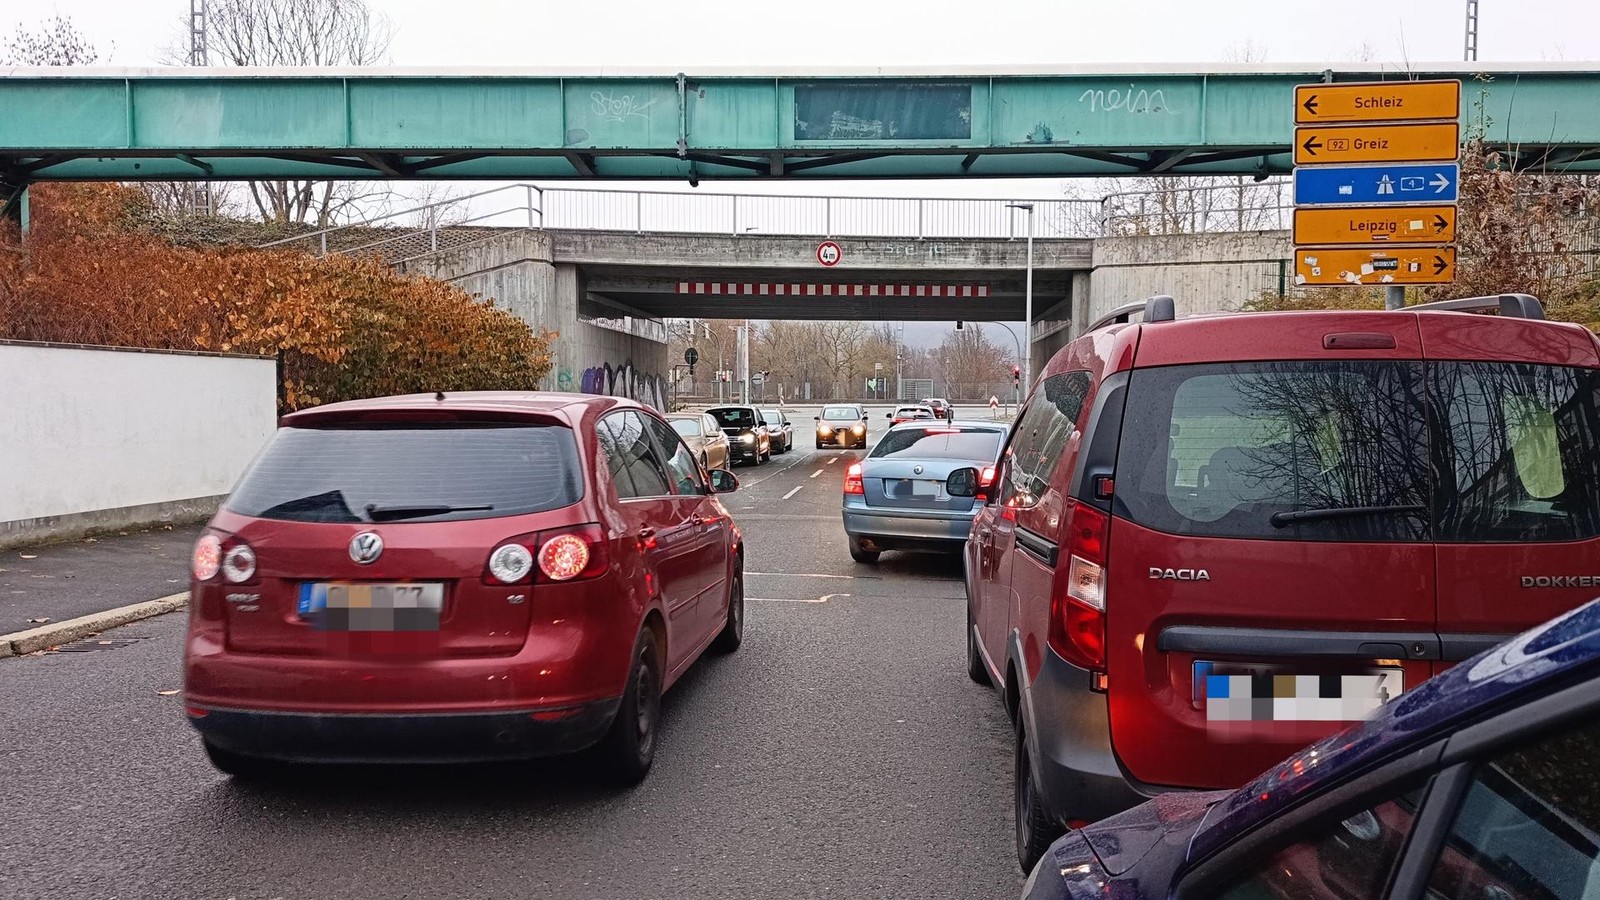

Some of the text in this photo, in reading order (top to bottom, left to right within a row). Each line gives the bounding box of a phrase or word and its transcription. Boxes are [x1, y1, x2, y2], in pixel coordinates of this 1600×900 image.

[1354, 96, 1403, 109] Schleiz
[1332, 138, 1389, 150] 92 Greiz
[1408, 179, 1416, 188] 4
[1350, 219, 1397, 233] Leipzig
[1149, 567, 1211, 580] DACIA
